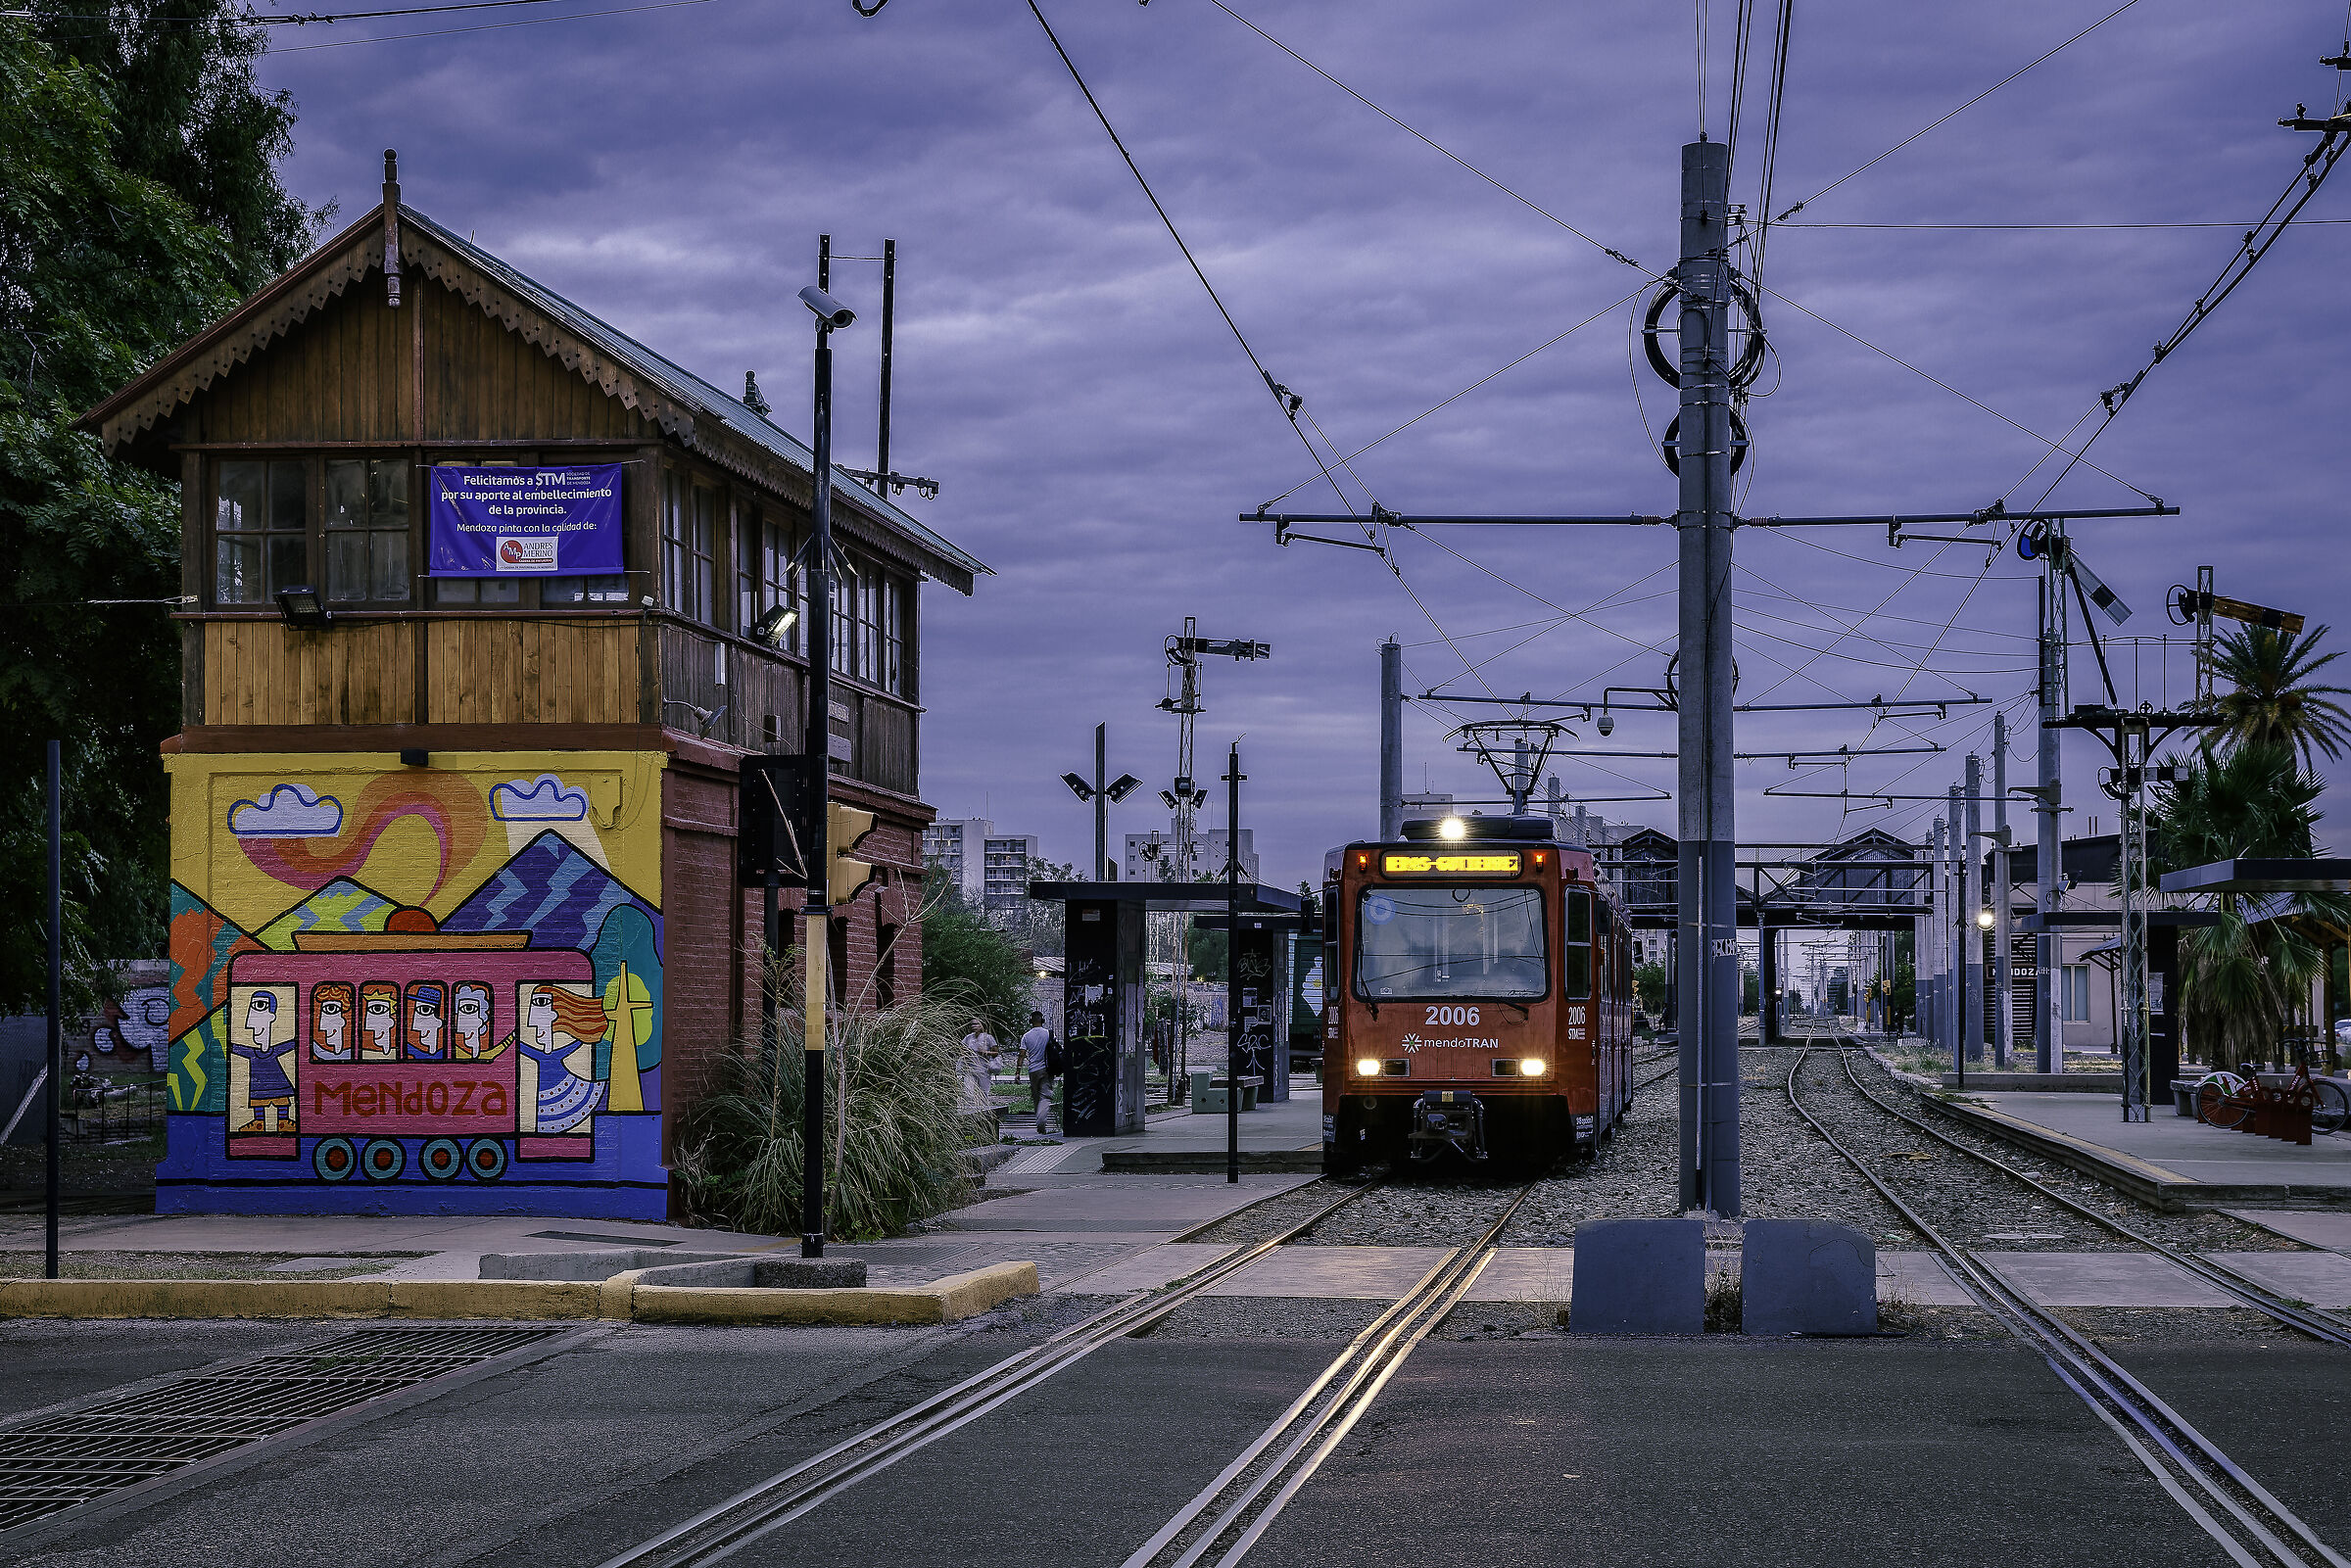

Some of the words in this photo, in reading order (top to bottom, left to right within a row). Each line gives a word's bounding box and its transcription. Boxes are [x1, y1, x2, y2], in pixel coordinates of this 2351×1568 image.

[463, 476, 525, 486] Felicitamos
[441, 492, 457, 501] por
[475, 490, 510, 500] aporte
[513, 491, 523, 499] al
[525, 488, 611, 499] embellecimiento
[489, 505, 502, 515] de
[504, 505, 513, 515] la
[516, 505, 566, 517] provincia.
[499, 524, 522, 534] pinta
[543, 524, 551, 533] la
[552, 522, 581, 532] calidad
[1425, 1006, 1480, 1026] 2006
[1568, 1006, 1586, 1024] 2006
[1424, 1037, 1499, 1050] mendoTRAN
